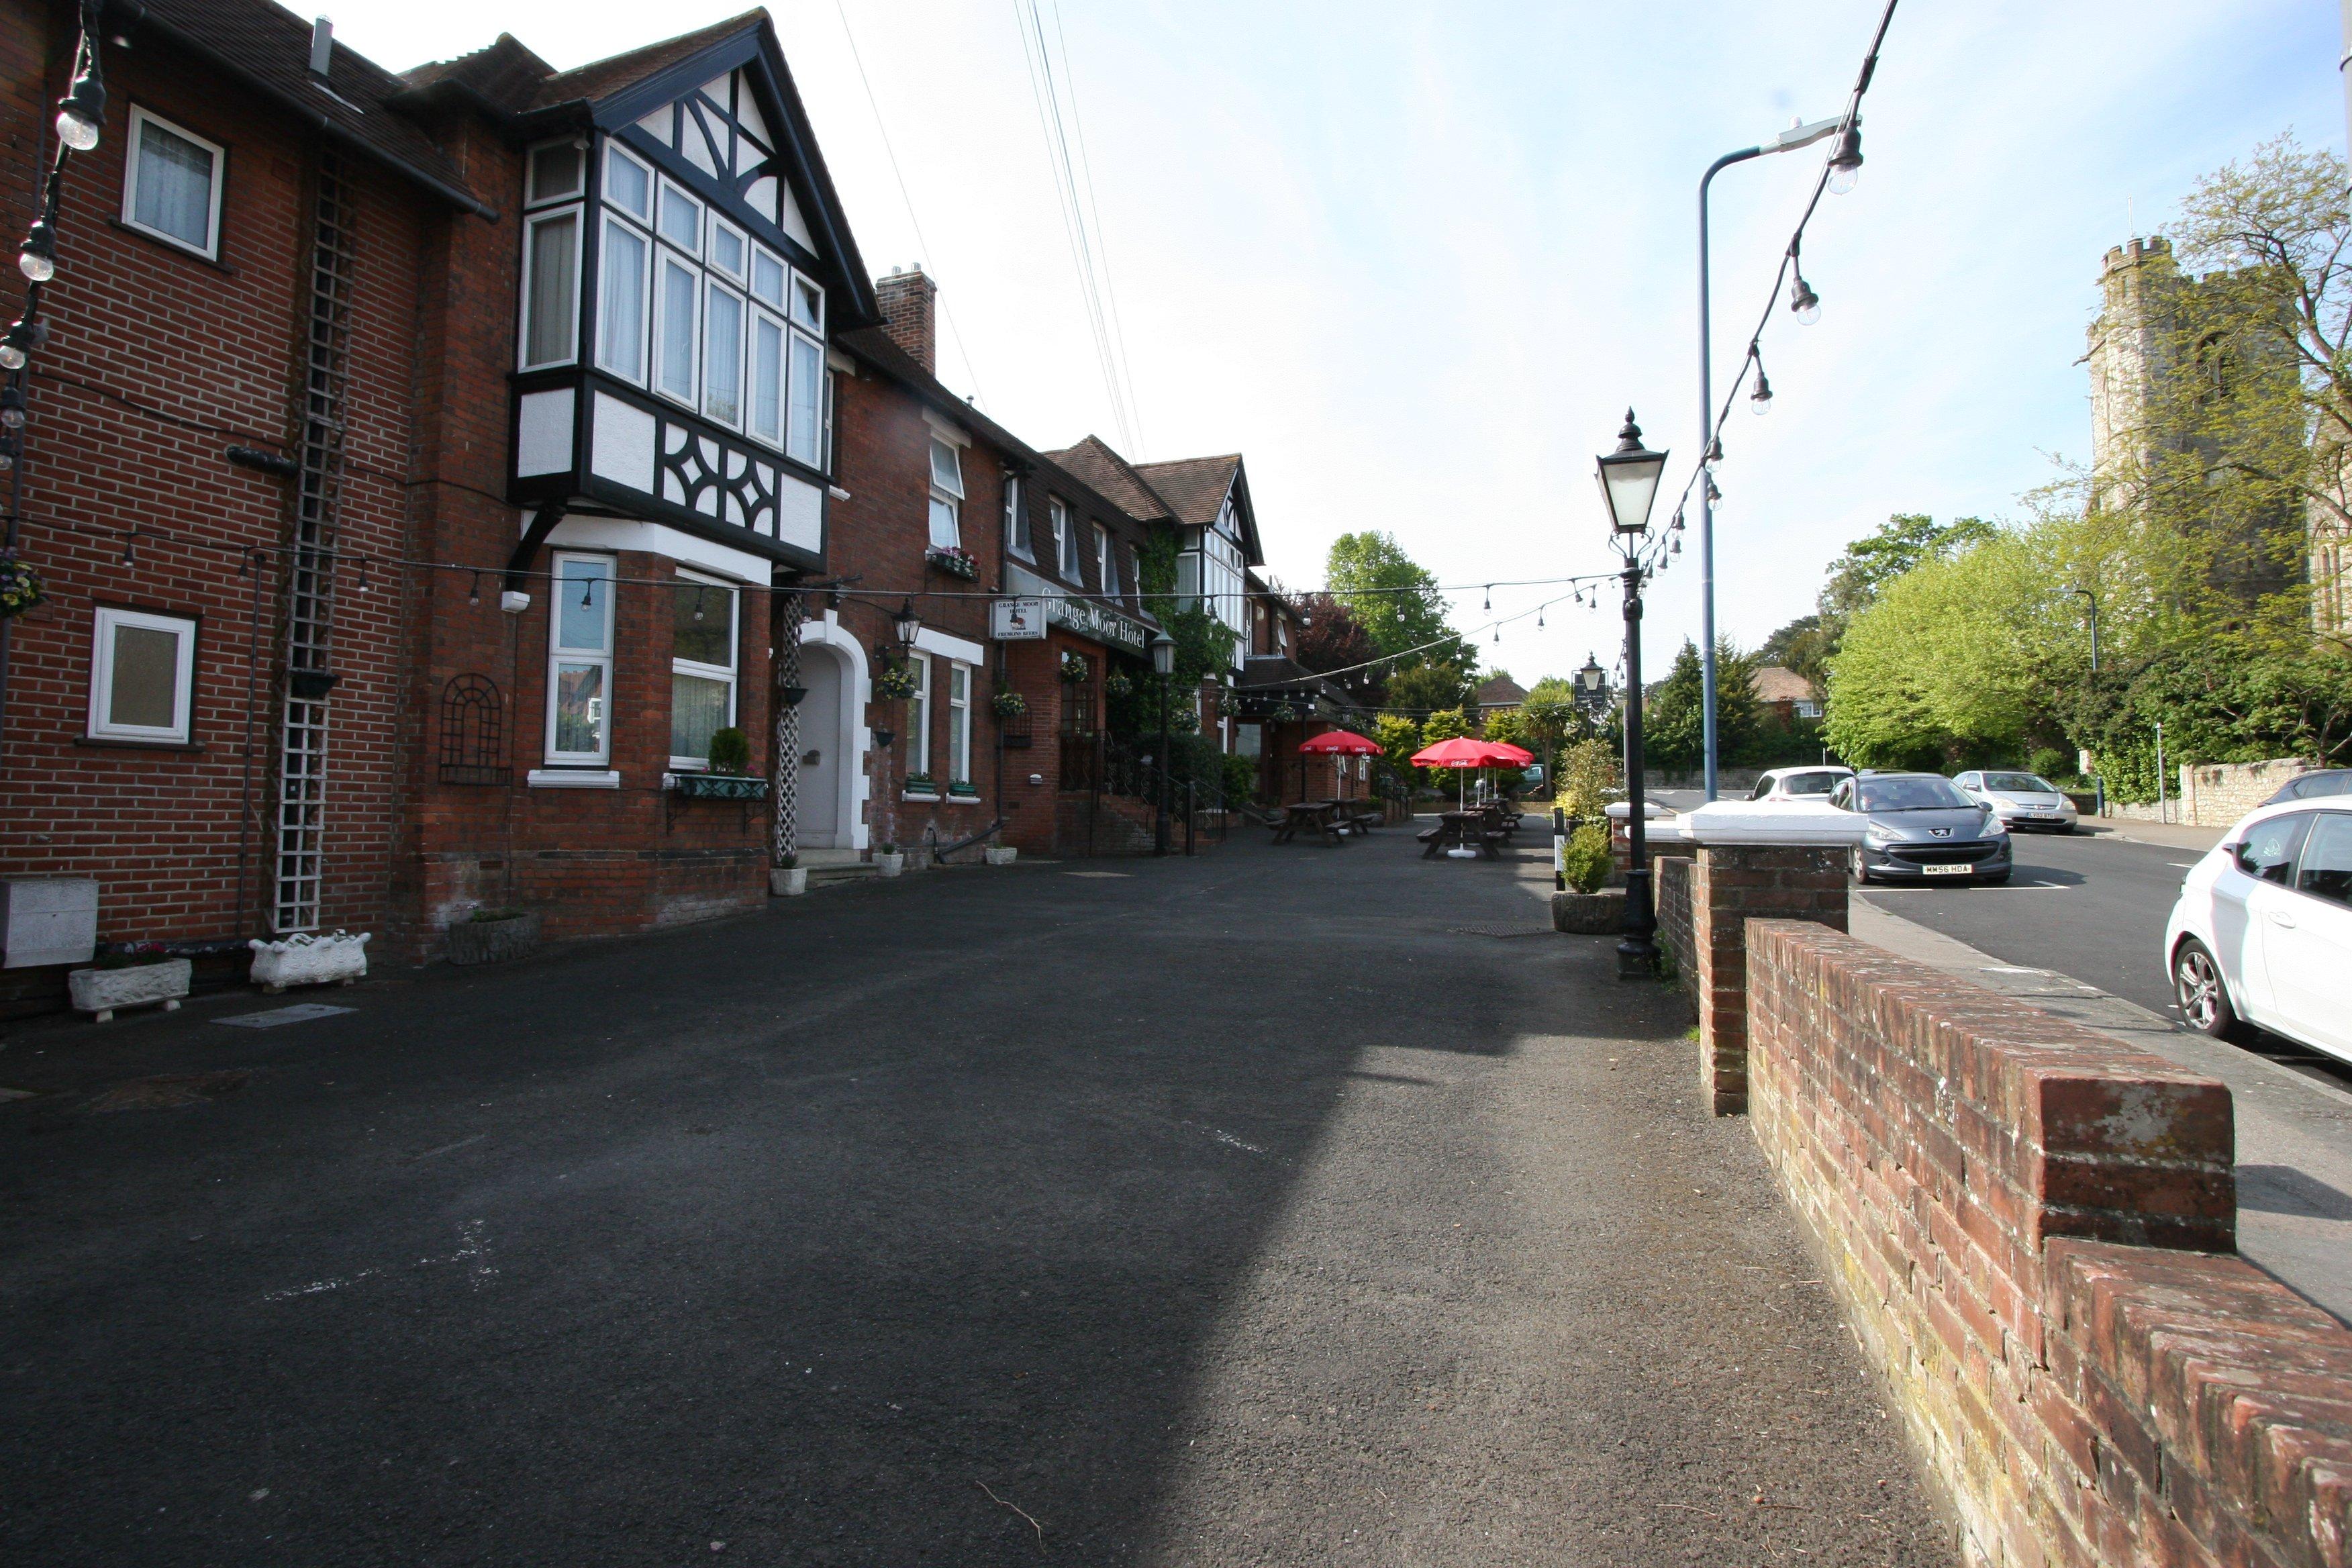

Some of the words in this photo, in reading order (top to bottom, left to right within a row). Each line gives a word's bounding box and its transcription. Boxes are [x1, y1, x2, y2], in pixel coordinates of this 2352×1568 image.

[1042, 587, 1085, 630] Grange
[1089, 607, 1117, 637] Moor
[1120, 620, 1144, 648] Hotel
